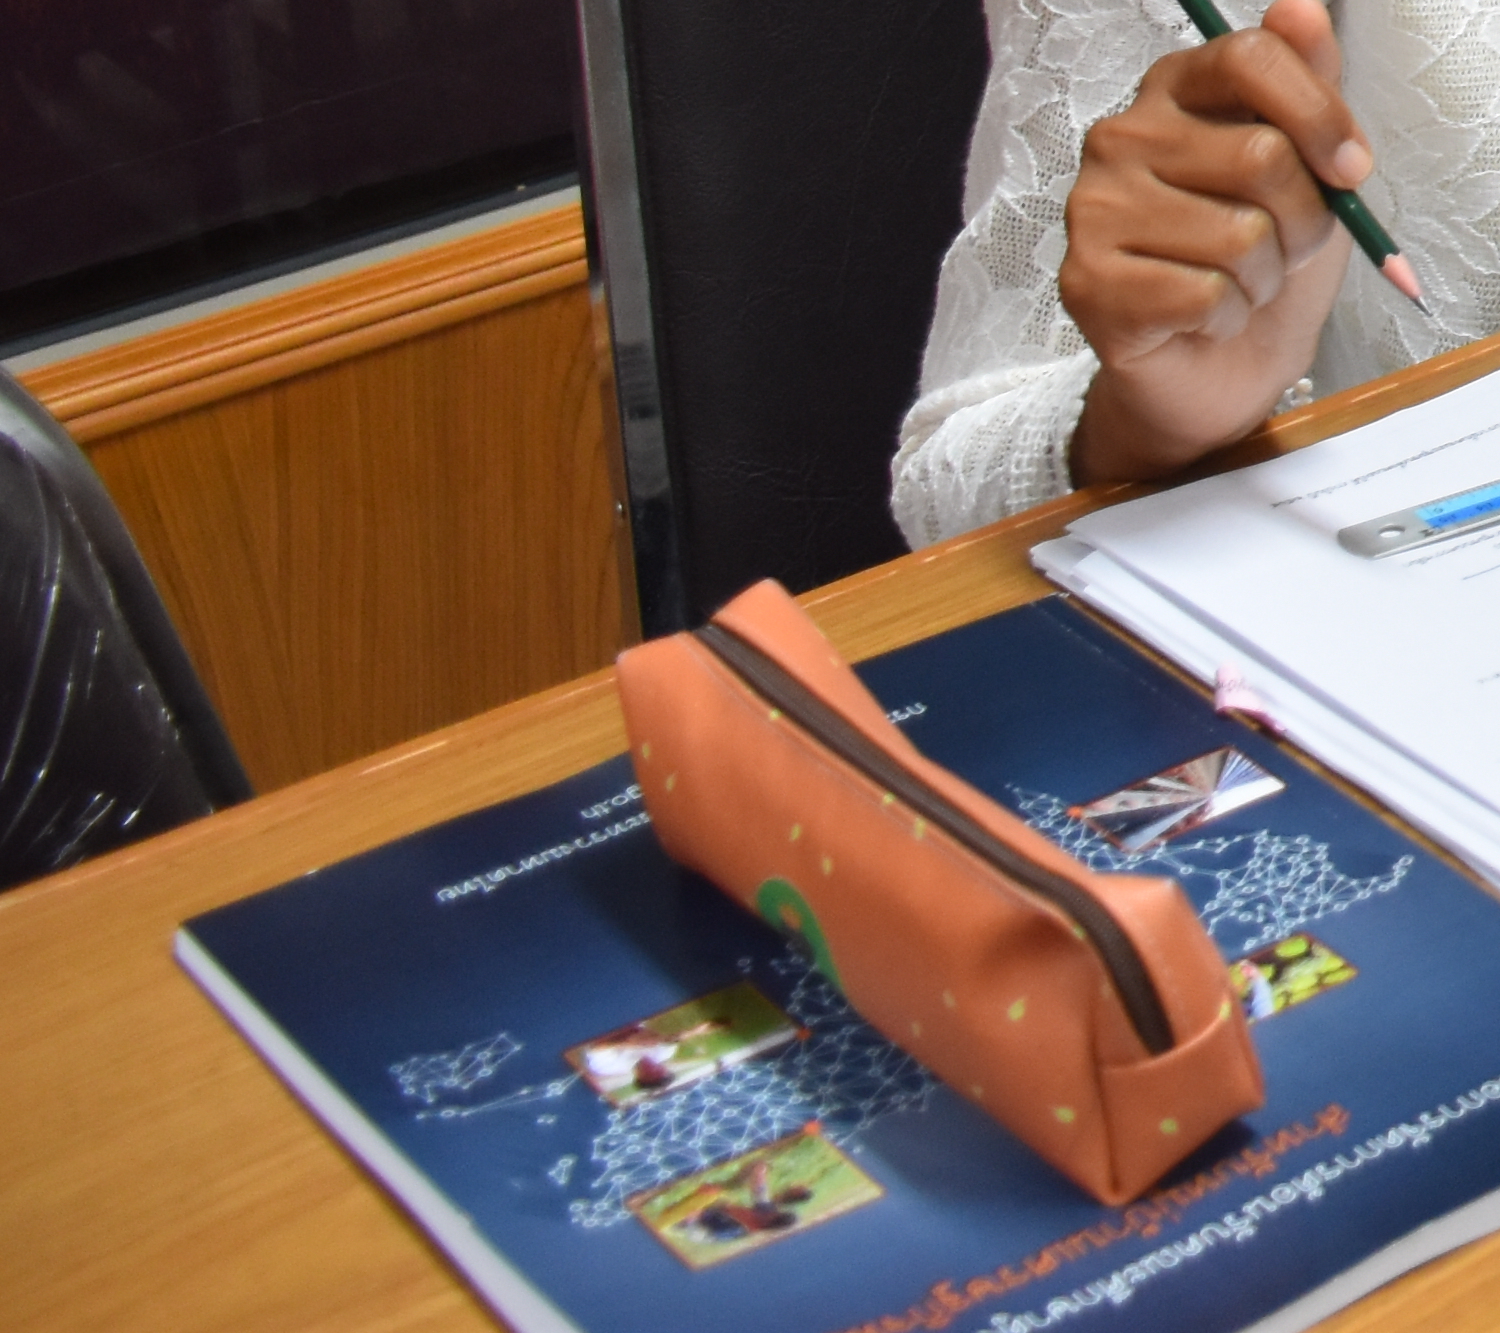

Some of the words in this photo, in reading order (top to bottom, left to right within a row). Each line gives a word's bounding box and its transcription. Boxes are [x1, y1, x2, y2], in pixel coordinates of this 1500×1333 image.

[886, 702, 928, 726] กร
[581, 784, 643, 820] go.th
[436, 811, 652, 903] ระทรวงมหาดไทย
